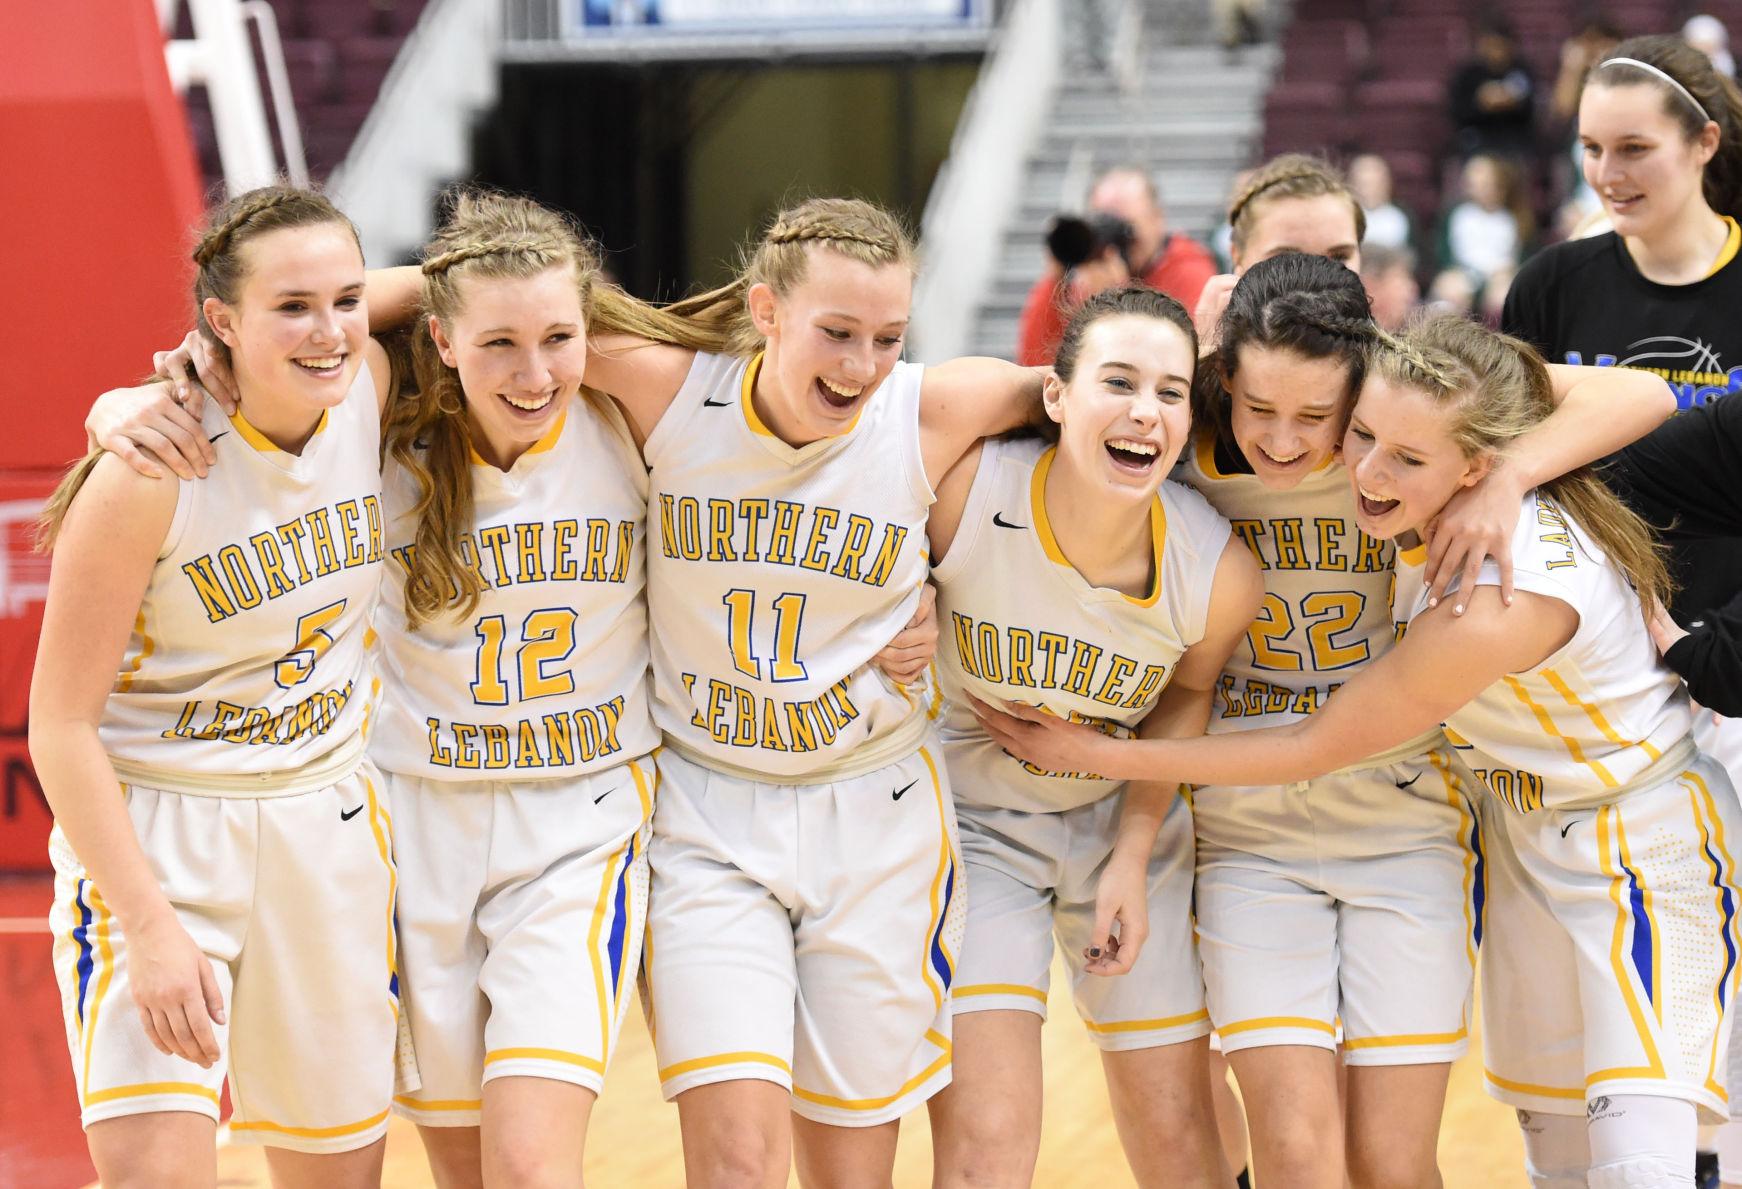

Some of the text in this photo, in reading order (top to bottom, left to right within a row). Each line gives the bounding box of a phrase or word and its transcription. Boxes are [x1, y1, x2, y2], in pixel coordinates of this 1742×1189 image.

[182, 492, 385, 624] NORTHER
[391, 518, 634, 601] NRTHERN
[659, 492, 908, 587] NORTHERN
[1230, 517, 1396, 573] THER
[274, 598, 347, 689] 5
[470, 606, 579, 705] 12
[723, 588, 810, 683] 11
[952, 611, 1175, 709] NORTHER
[1247, 590, 1371, 672] 22
[427, 695, 625, 769] LEBANON
[682, 672, 860, 752] LEBANON
